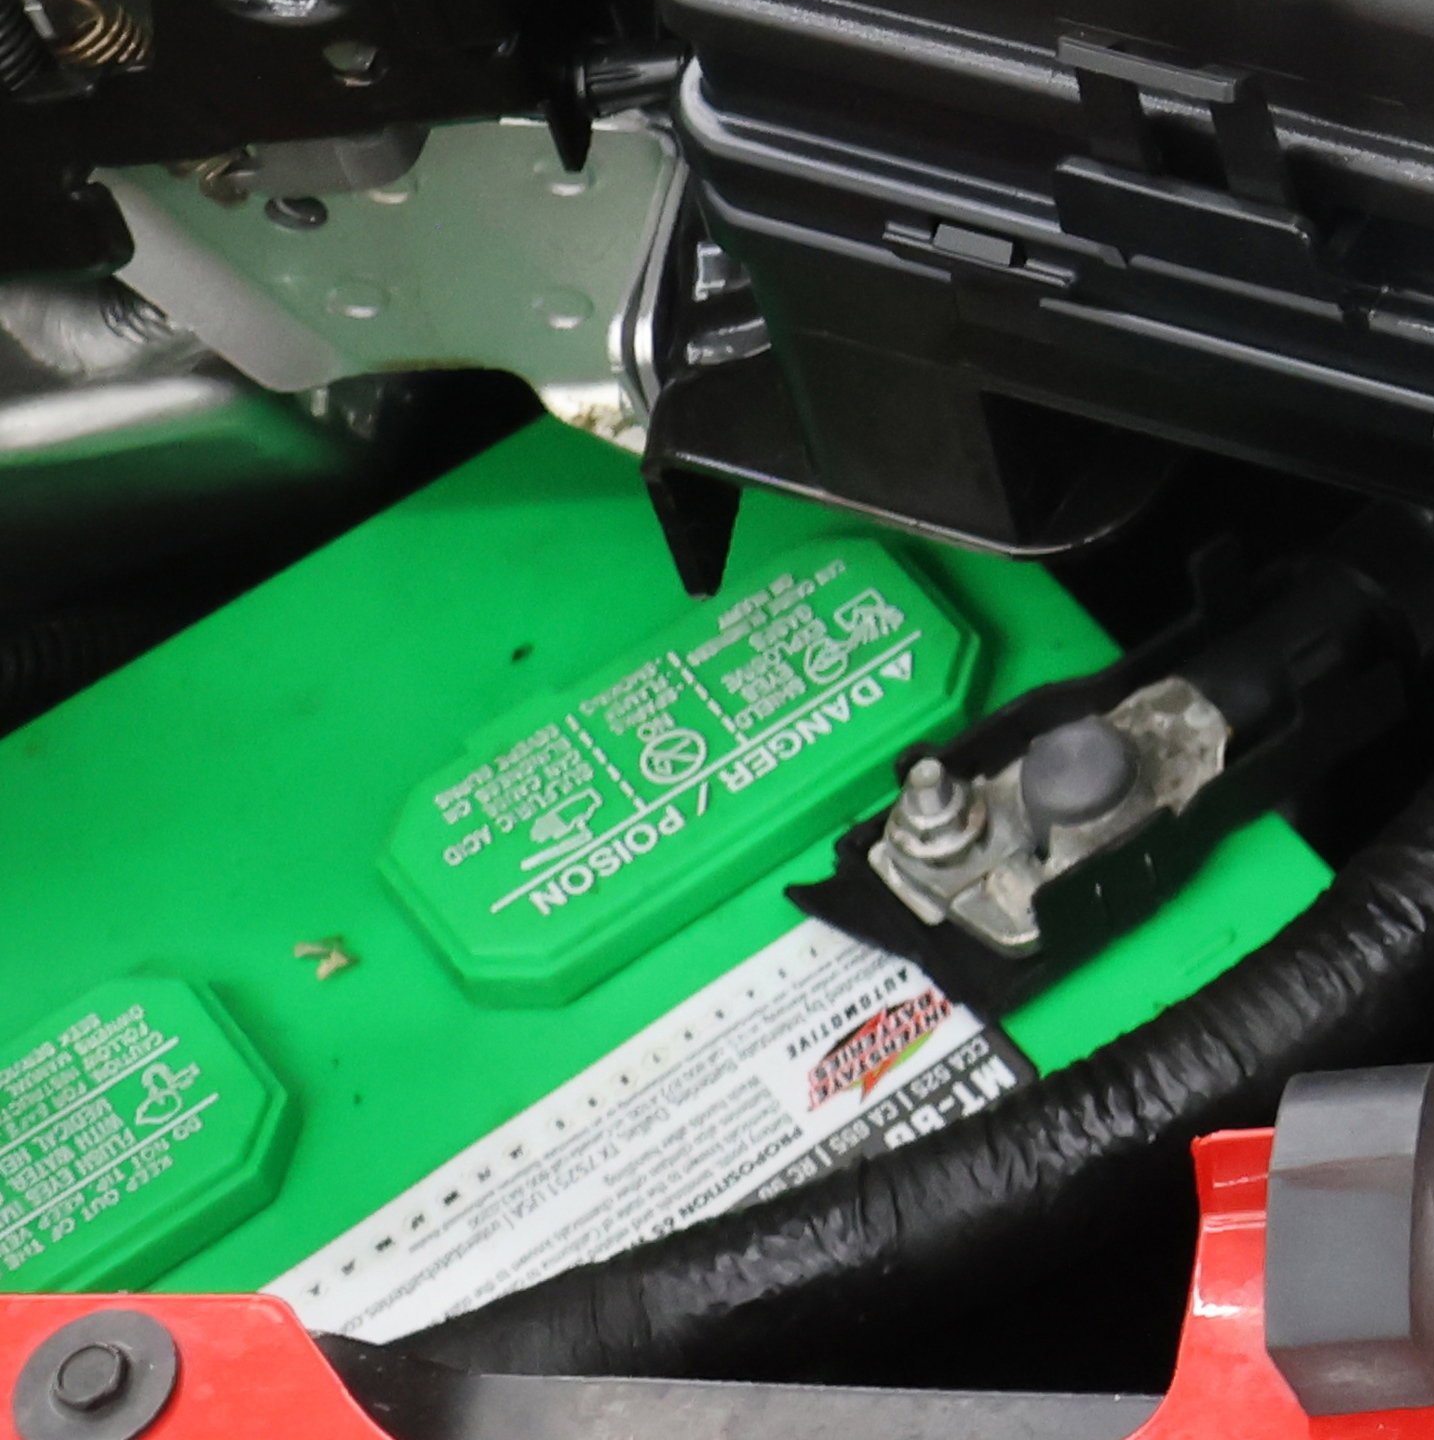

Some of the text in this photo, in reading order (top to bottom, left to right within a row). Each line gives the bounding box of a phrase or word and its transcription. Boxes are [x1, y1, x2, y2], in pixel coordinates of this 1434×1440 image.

[716, 673, 886, 796] DANGER
[440, 823, 495, 869] ACID
[527, 803, 686, 917] POISON
[784, 967, 911, 1059] AUTOMOTIVE
[946, 1035, 991, 1073] CCA
